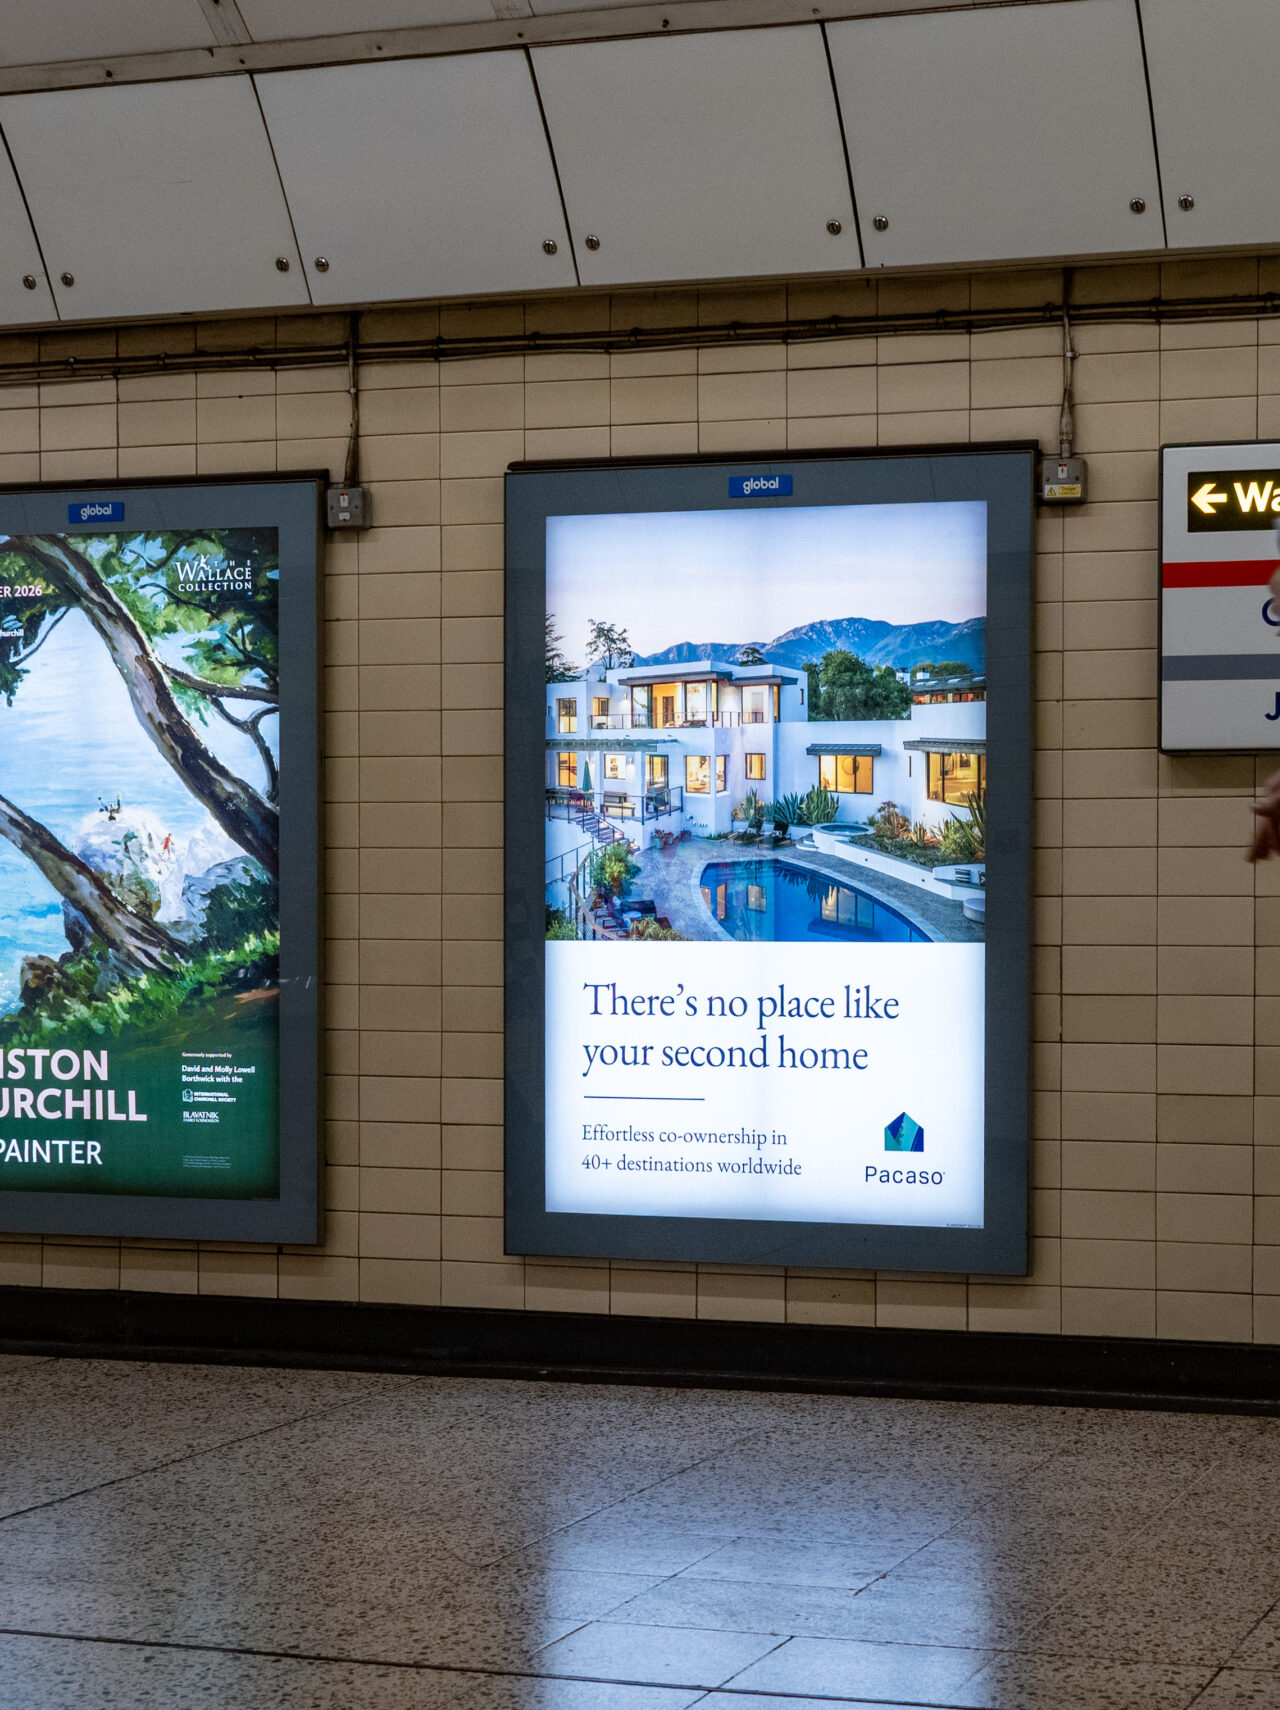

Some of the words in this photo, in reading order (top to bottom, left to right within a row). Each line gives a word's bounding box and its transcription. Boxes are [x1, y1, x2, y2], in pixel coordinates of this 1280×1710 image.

[743, 476, 779, 494] global
[80, 503, 112, 520] global
[175, 561, 252, 582] WALLACE
[214, 559, 252, 567] THE
[14, 584, 43, 597] 2026
[178, 581, 252, 592] COLLECTION
[582, 982, 698, 1017] There’s
[706, 995, 748, 1017] no
[756, 983, 836, 1030] place
[843, 984, 900, 1019] like
[582, 1043, 654, 1077] your
[661, 1034, 770, 1068] second
[777, 1034, 869, 1070] home
[181, 1065, 200, 1073] David
[201, 1065, 214, 1073] and
[214, 1065, 233, 1074] Molly
[233, 1065, 256, 1073] Lowell
[181, 1074, 215, 1082] Borthwick
[215, 1075, 231, 1083] with
[231, 1075, 243, 1083] the
[581, 1124, 655, 1143] Effortless
[658, 1127, 767, 1150] co-ownership
[771, 1129, 788, 1146] in
[581, 1154, 613, 1170] 40+
[616, 1153, 713, 1173] destinations
[716, 1157, 802, 1176] worldwide
[865, 1165, 944, 1185] Pacaso
